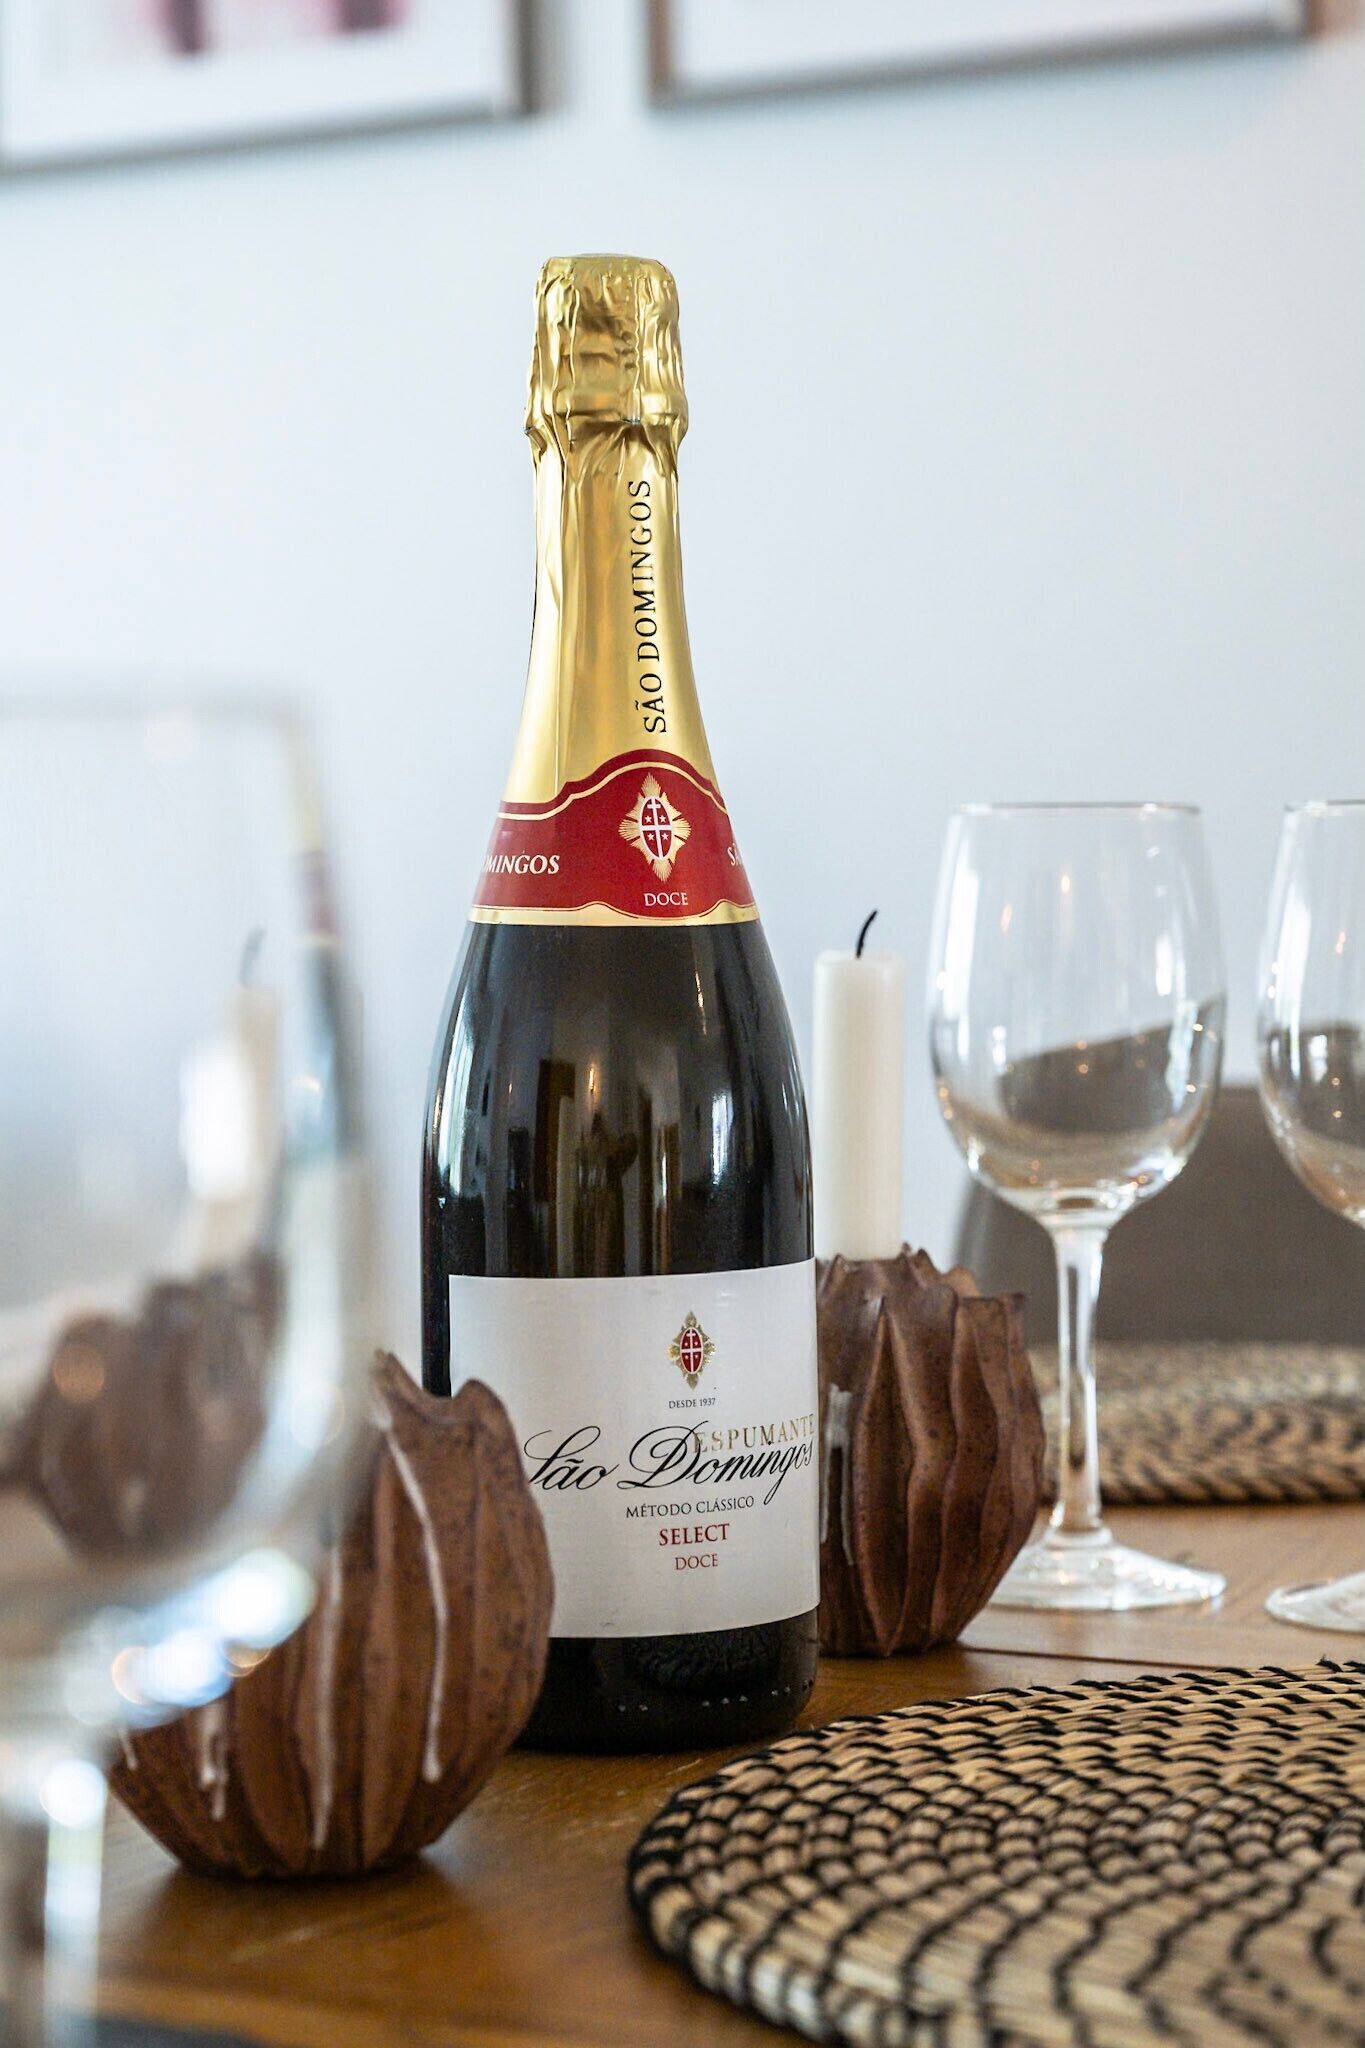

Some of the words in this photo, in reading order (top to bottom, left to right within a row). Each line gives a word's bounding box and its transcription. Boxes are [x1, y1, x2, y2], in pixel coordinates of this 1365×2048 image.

[628, 479, 661, 662] DOMINGOS
[636, 673, 667, 733] SÃO
[644, 892, 689, 906] DOCE
[668, 1399, 697, 1409] DESDE
[699, 1397, 716, 1407] 1937
[692, 1413, 815, 1454] ESPUMANTE
[523, 1425, 620, 1490] São
[617, 1420, 814, 1506] Domingos
[625, 1499, 692, 1518] MÉTODO
[696, 1495, 755, 1514] CLÁSSICO
[658, 1523, 730, 1546] SELECT
[675, 1554, 719, 1571] DOCE
